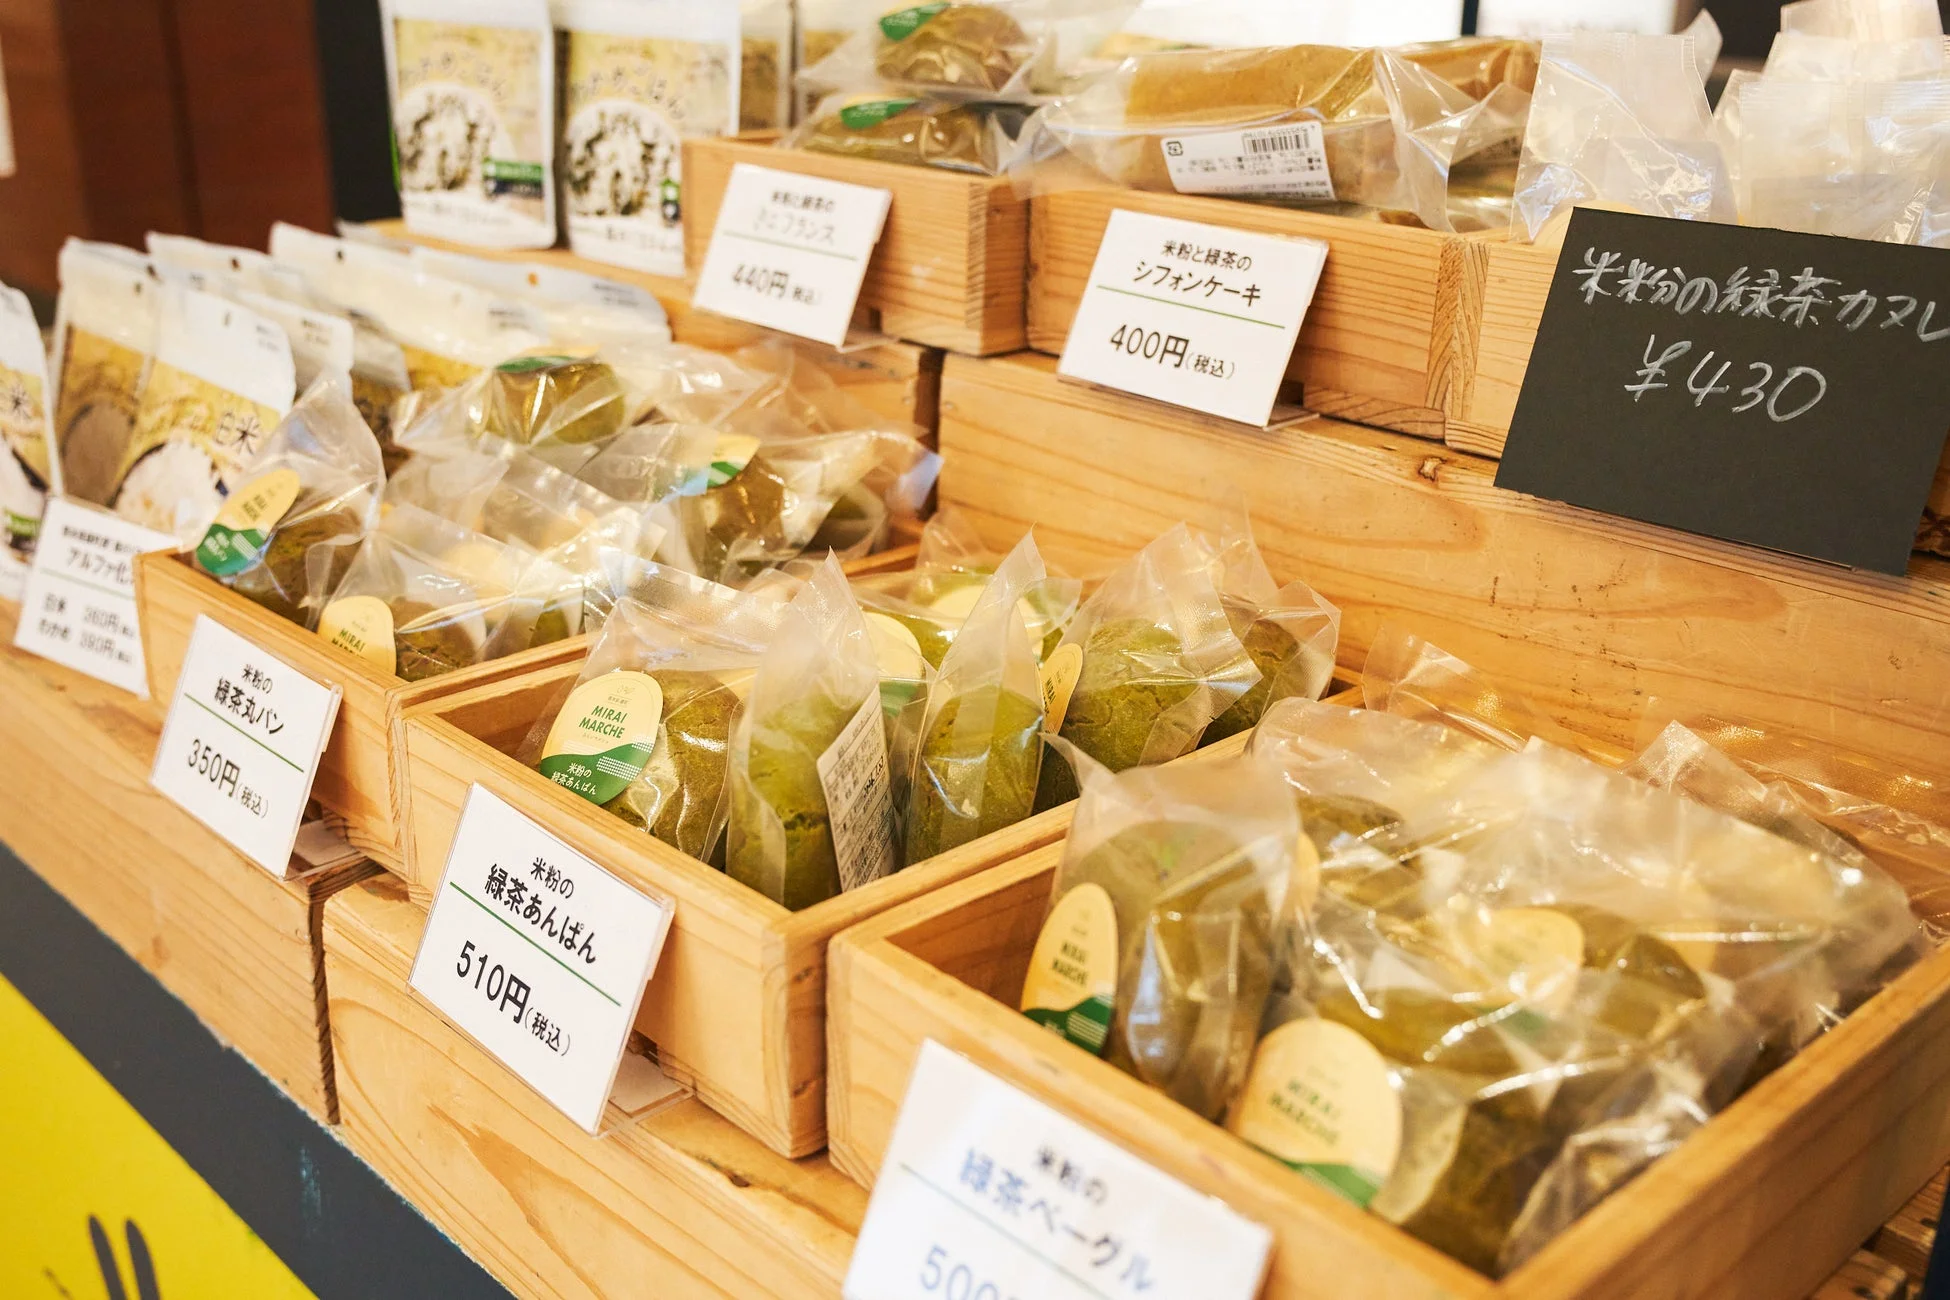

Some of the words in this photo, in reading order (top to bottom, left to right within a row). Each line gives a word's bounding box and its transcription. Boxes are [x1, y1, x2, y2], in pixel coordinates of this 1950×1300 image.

[1161, 239, 1253, 272] 米粉と緑茶の
[1133, 260, 1262, 307] シフォンケーキ
[1572, 247, 1950, 343] 米粉の緑茶カヌレ
[1623, 333, 1827, 423] ¥430
[215, 409, 261, 456] 白米
[67, 546, 135, 586] アルファ化
[339, 628, 366, 652] MIRAI
[241, 663, 274, 694] 米粉の
[214, 677, 285, 735] 緑茶丸パン
[578, 716, 626, 739] MARCHE
[591, 705, 627, 724] MIRAI
[567, 762, 592, 778] 米粉の
[530, 856, 575, 899] 米粉の
[483, 863, 597, 964] 緑茶あんぱん
[1035, 1144, 1109, 1206] 米粉の
[958, 1147, 1156, 1294] 緑茶ベーグル
